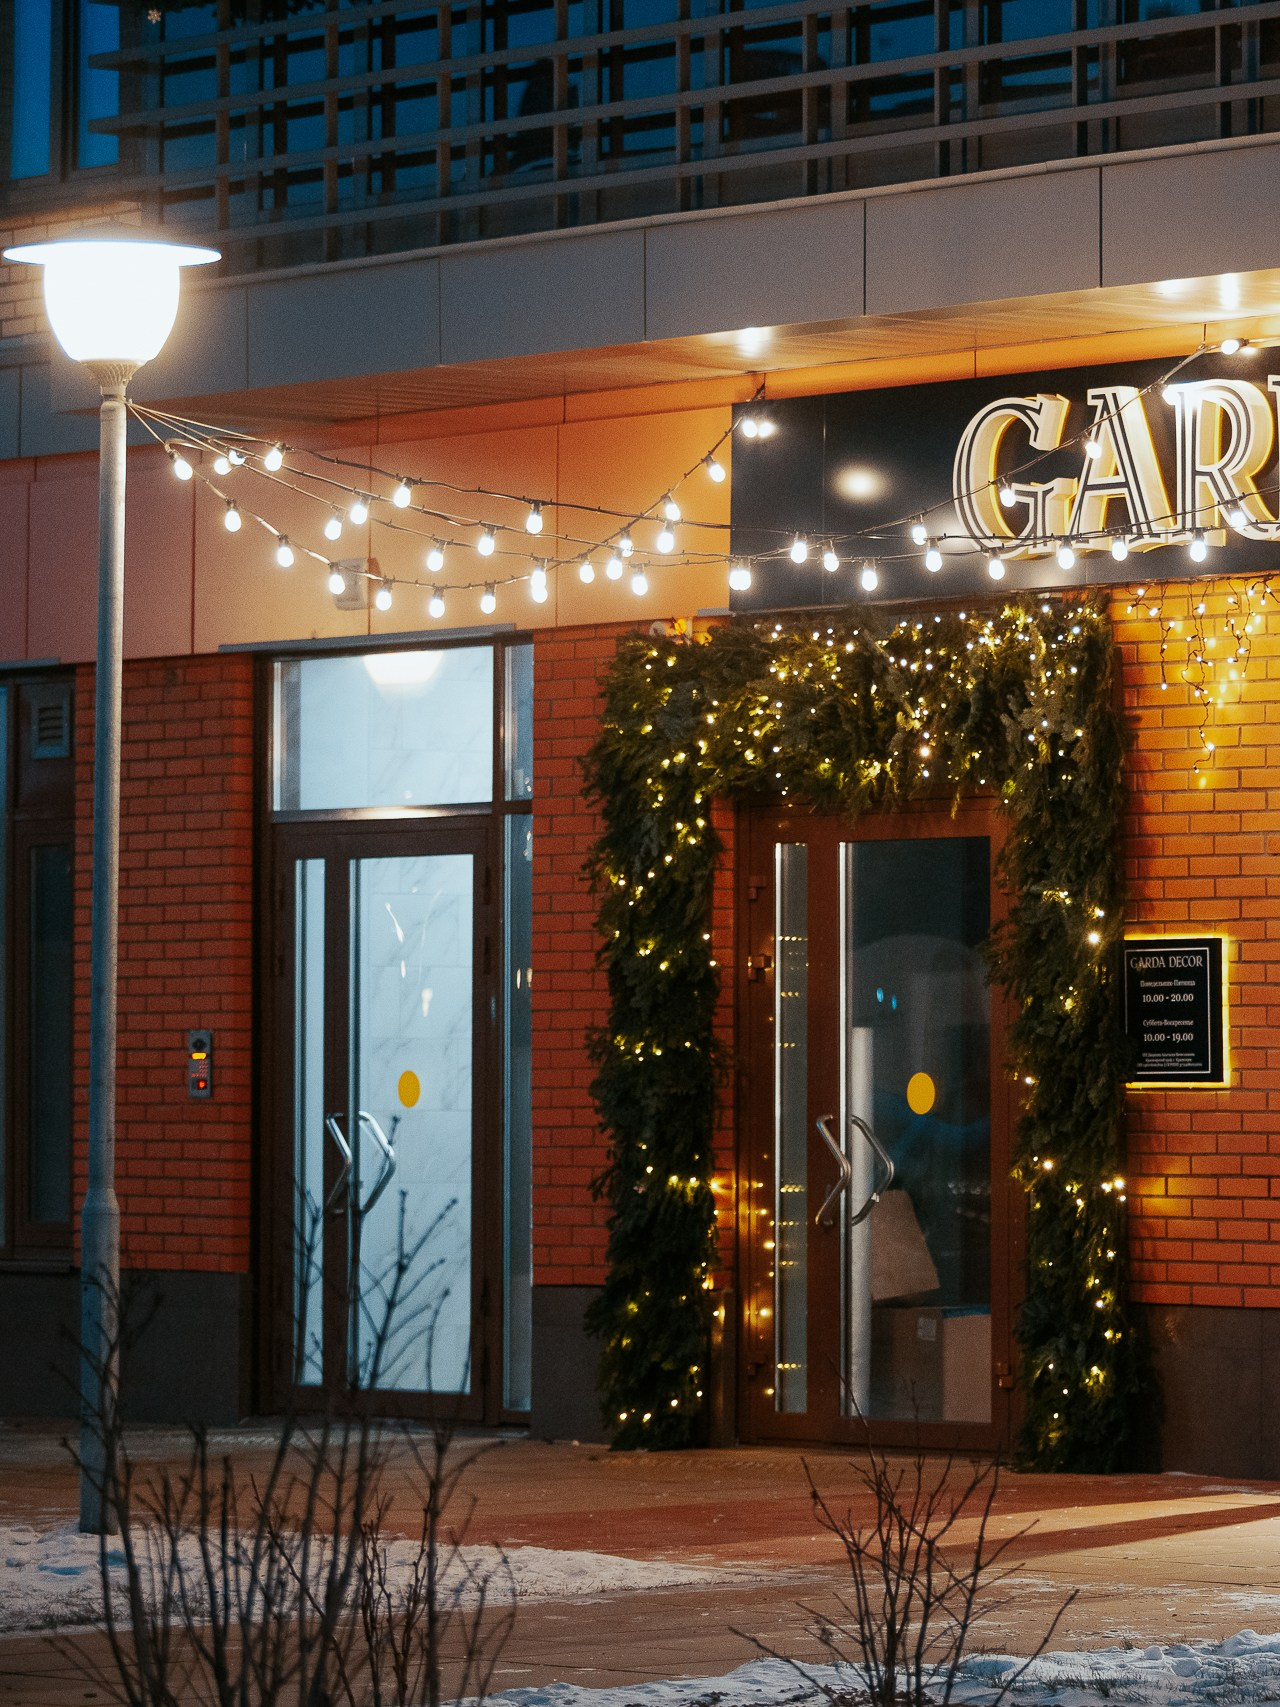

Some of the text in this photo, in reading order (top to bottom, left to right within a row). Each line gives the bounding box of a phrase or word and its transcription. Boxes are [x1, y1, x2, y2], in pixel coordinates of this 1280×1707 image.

[1130, 956, 1203, 969] GARDA DECOR
[1142, 994, 1164, 1003] 10.00
[1170, 993, 1194, 1002] 20.00
[1143, 1033, 1166, 1042] 10.00
[1172, 1033, 1194, 1043] 19.00
